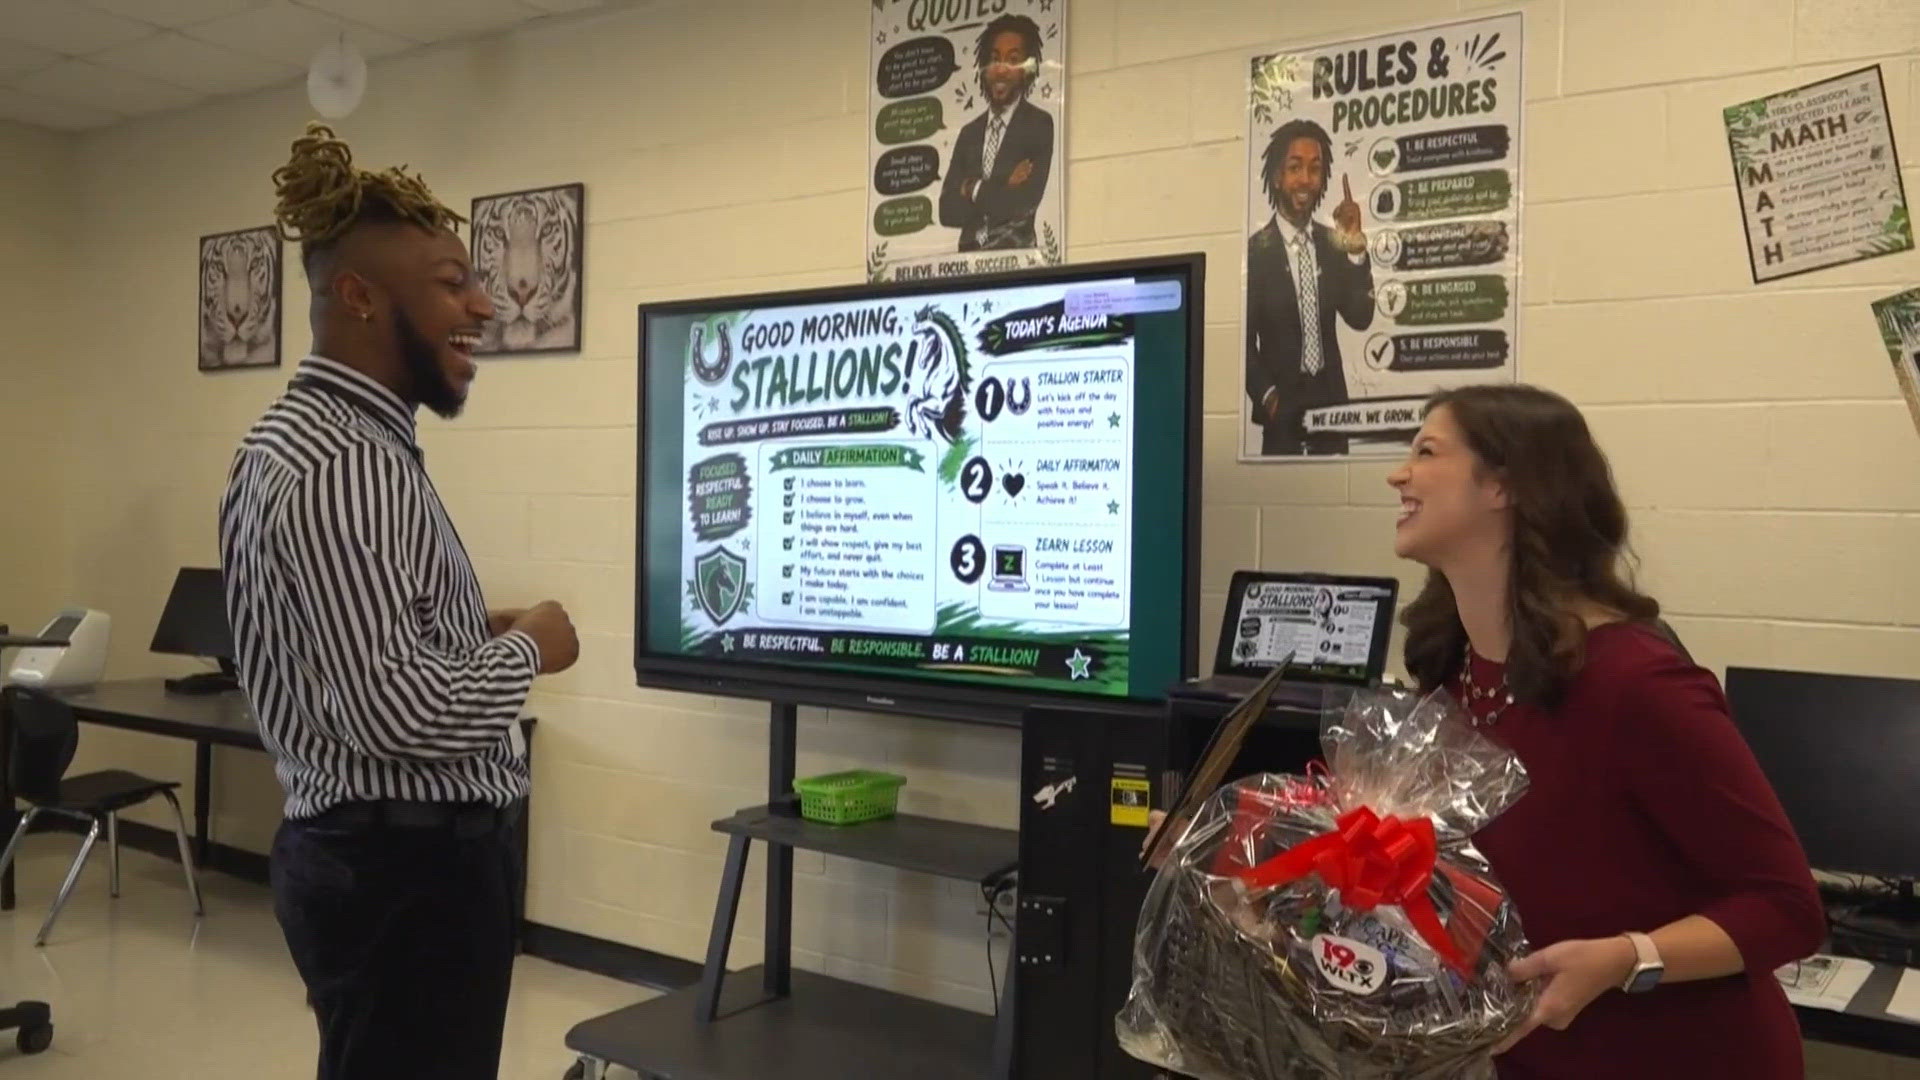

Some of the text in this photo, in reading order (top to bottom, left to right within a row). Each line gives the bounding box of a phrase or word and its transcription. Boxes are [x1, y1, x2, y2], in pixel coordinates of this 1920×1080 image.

[1312, 37, 1450, 100] RULES &
[1333, 77, 1497, 134] PROCEDURES
[1414, 138, 1424, 151] BE
[1427, 132, 1478, 149] RESPECTFUL
[1770, 113, 1848, 154] MATH
[1418, 181, 1429, 194] BE
[1431, 176, 1475, 192] PREPARED
[938, 260, 971, 276] FOCUS.
[975, 255, 1020, 273] SUCCEED.
[1422, 283, 1432, 296] BE
[1435, 281, 1477, 294] ENGAGED
[741, 304, 903, 353] GOOD MORNING,
[1005, 313, 1108, 340] TODAY'S AGENDA
[1410, 337, 1420, 350] BE
[1423, 334, 1479, 349] RESPONSIBLE
[730, 340, 919, 413] STALLIONS!
[1037, 369, 1123, 386] STALLION STARTER
[985, 382, 995, 416] 1
[1057, 392, 1071, 402] kick
[1075, 391, 1086, 401] off
[1088, 391, 1100, 400] the
[1103, 392, 1117, 402] day
[1037, 405, 1092, 415] with focus and
[1312, 413, 1326, 427] WE
[1329, 411, 1363, 427] LEARN.
[1366, 409, 1380, 424] WE
[1384, 408, 1415, 423] GROW.
[707, 428, 722, 441] RISE
[737, 424, 757, 438] SHOW
[772, 420, 789, 433] STAY
[790, 417, 825, 432] FOCUSED.
[827, 415, 838, 428] BE
[839, 414, 847, 427] A
[1037, 420, 1064, 430] positive
[792, 449, 898, 464] DAILY AFFIRMATION
[700, 462, 737, 480] FOCUSED
[1037, 458, 1120, 472] DAILY AFFIRMATION
[695, 477, 743, 497] RESPECTFUL
[806, 478, 831, 488] choose
[834, 478, 843, 488] to
[967, 463, 984, 497] 2
[1037, 480, 1058, 491] Speak
[1072, 480, 1099, 491] Believe
[706, 493, 733, 510] READY
[806, 495, 831, 504] choose
[834, 495, 842, 504] to
[1036, 495, 1065, 504] Achieve
[700, 508, 742, 527] TO LEARN!
[806, 510, 831, 519] believe
[834, 510, 841, 519] in
[872, 512, 890, 520] even
[892, 511, 913, 520] when
[800, 522, 822, 534] things
[825, 525, 837, 533] are
[806, 538, 818, 547] will
[821, 538, 839, 547] show
[874, 540, 889, 552] give
[891, 542, 903, 552] my
[906, 541, 922, 551] best
[1035, 537, 1114, 553] ZEARN LESSON
[827, 551, 841, 560] and
[843, 553, 863, 561] never
[957, 542, 976, 576] 3
[800, 565, 924, 581] My future starts with the choices
[1035, 560, 1069, 571] Complete
[1072, 562, 1080, 570] at
[805, 579, 824, 588] make
[1069, 574, 1080, 584] but
[1083, 576, 1114, 585] continue
[856, 598, 868, 606] am
[1034, 588, 1120, 600] once you have complete
[1034, 602, 1050, 610] your
[743, 633, 1040, 666] BE RESPECTFUL. BE RESPONSIBLE. BE A STALLION!
[1322, 937, 1356, 969] 19
[1320, 958, 1373, 989] WLTX
